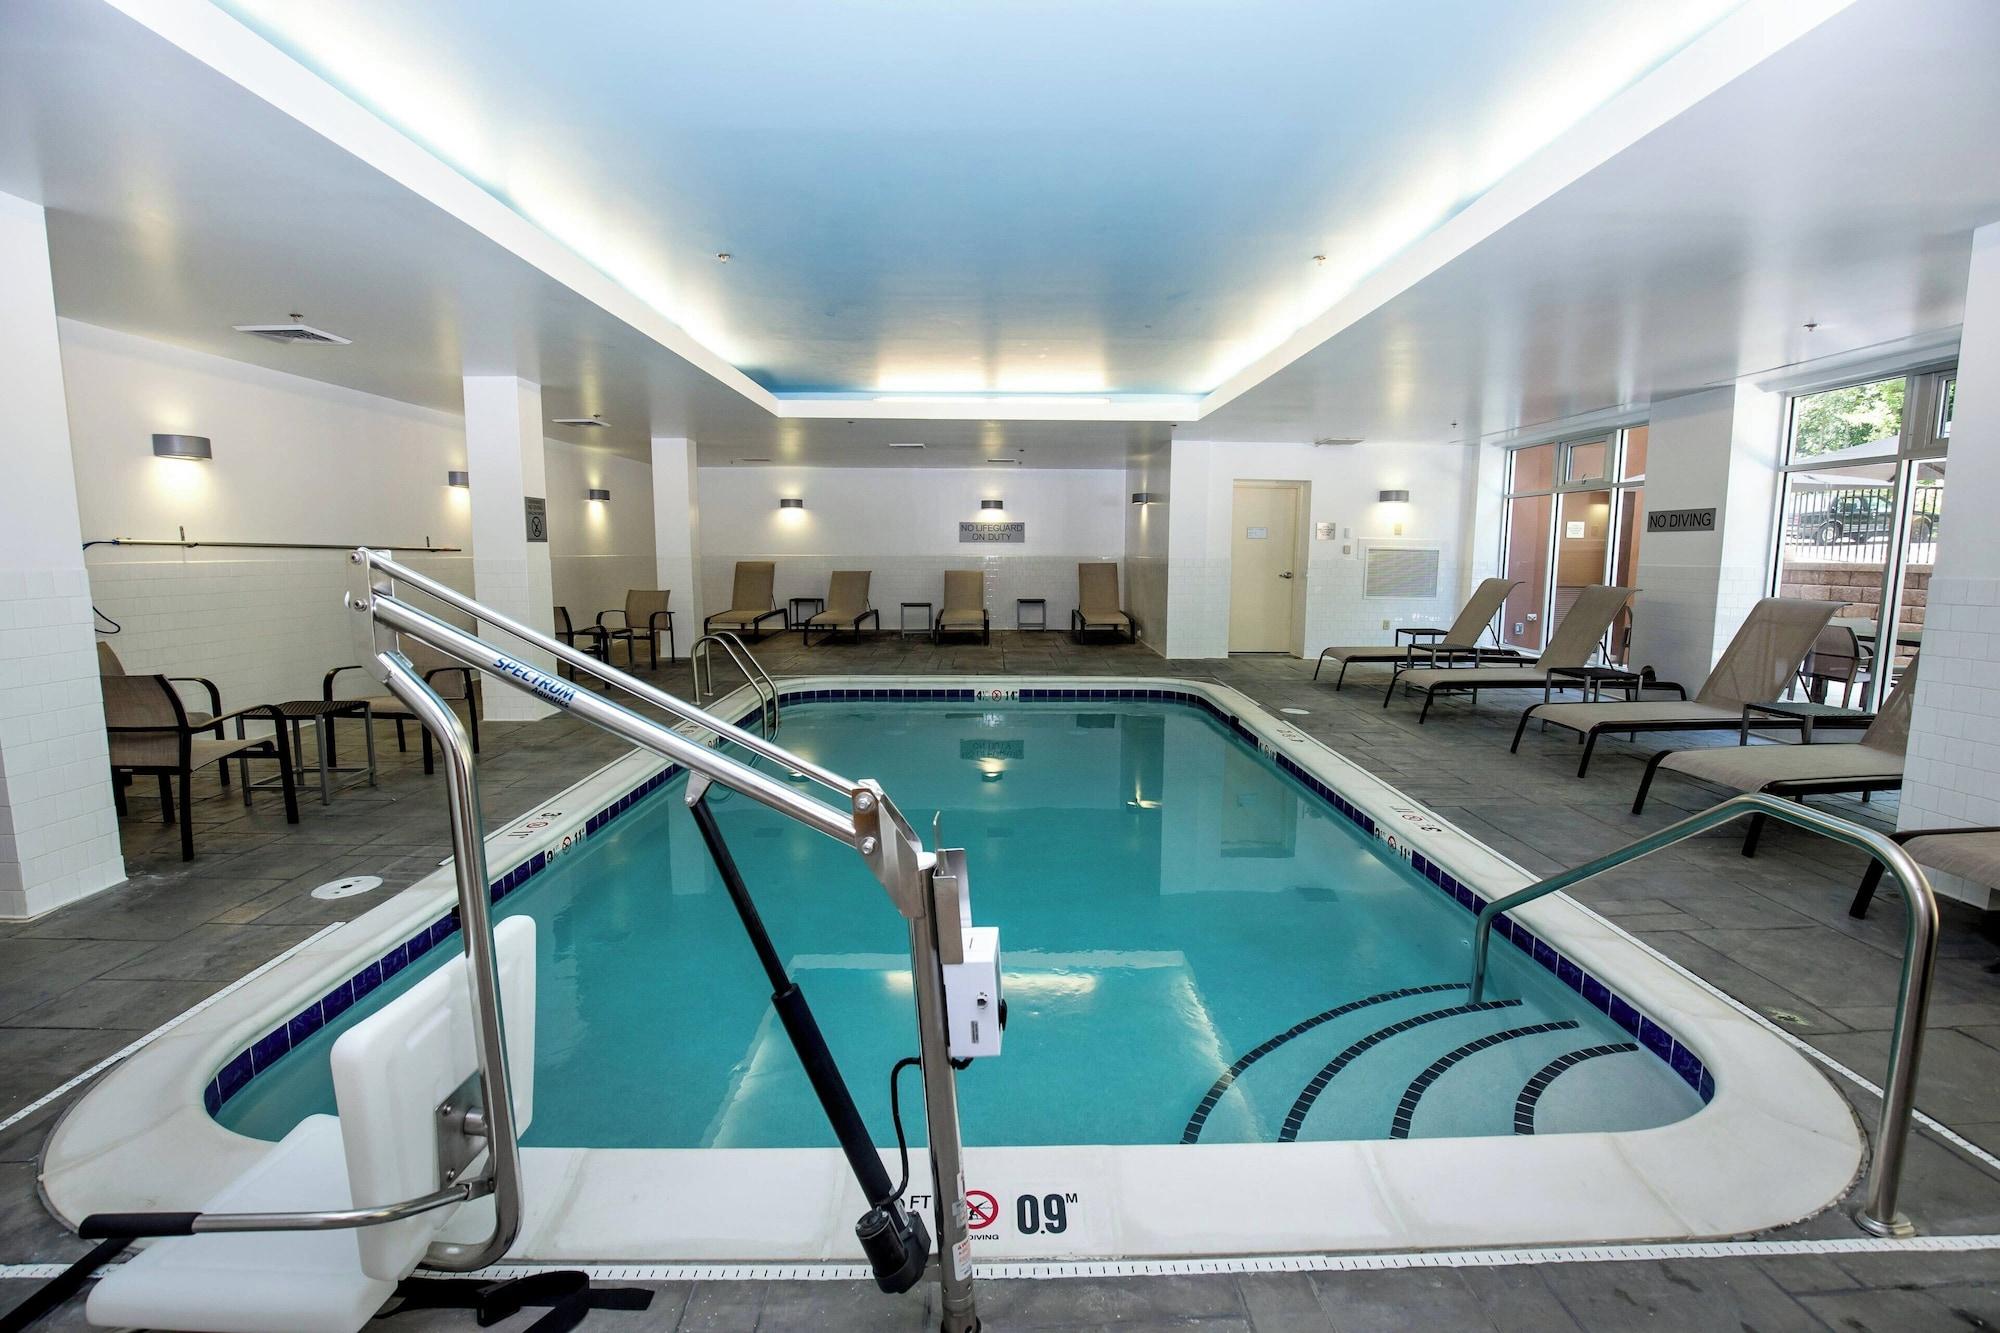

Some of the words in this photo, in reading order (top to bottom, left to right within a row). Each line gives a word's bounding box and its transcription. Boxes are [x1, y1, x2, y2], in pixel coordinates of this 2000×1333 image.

[1650, 514, 1666, 528] NO
[1670, 512, 1711, 527] DIVING
[961, 524, 974, 532] NO
[976, 524, 1023, 532] LIFEGUARD
[972, 533, 985, 541] ON
[988, 533, 1012, 541] DUTY
[493, 658, 576, 701] SPECTRUM
[531, 687, 569, 708] Aquatics
[910, 1195, 931, 1209] FT
